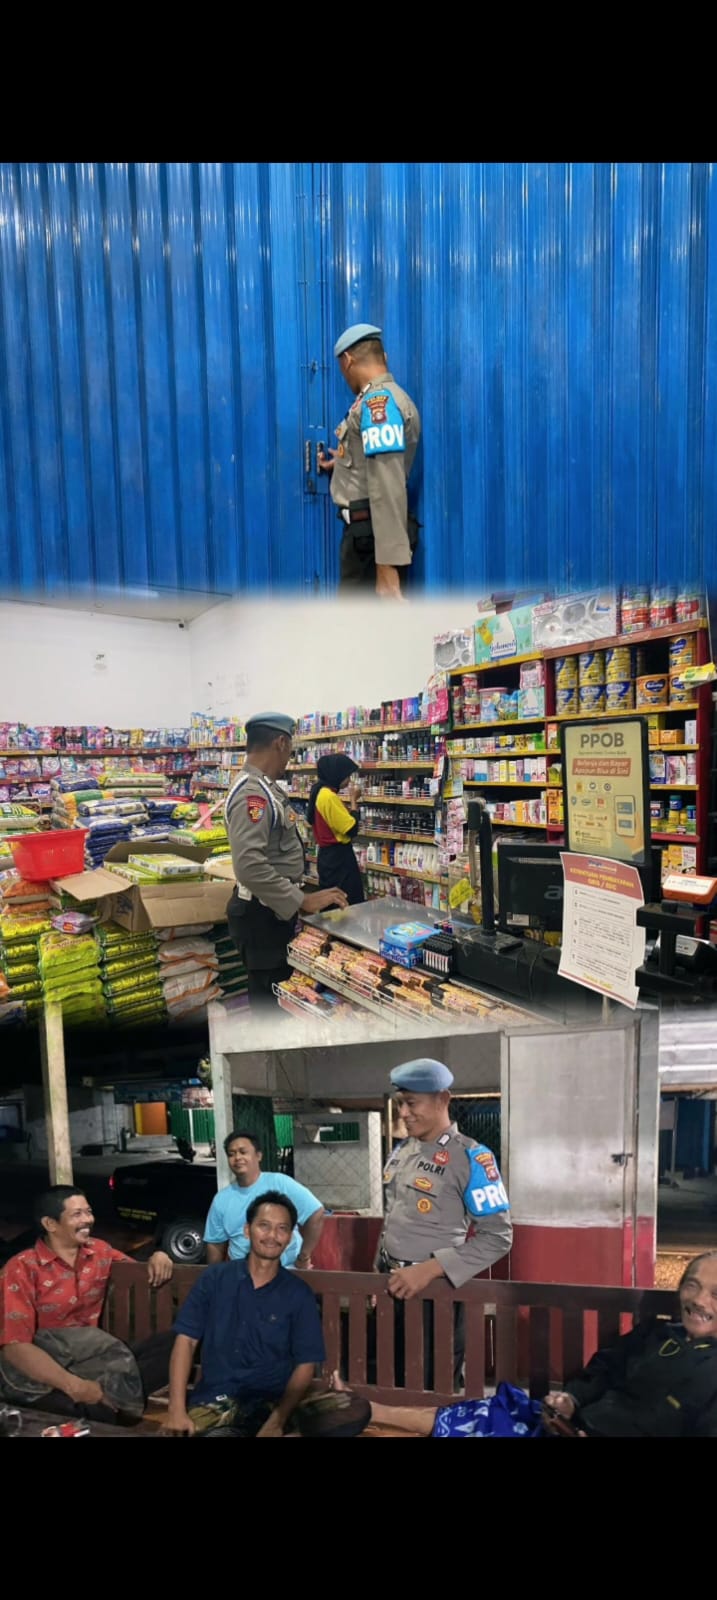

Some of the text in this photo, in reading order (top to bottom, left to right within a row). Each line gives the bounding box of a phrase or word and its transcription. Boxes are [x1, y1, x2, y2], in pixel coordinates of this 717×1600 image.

[362, 424, 404, 454] PROV
[580, 732, 624, 748] PPOB
[417, 1161, 445, 1176] POLRI
